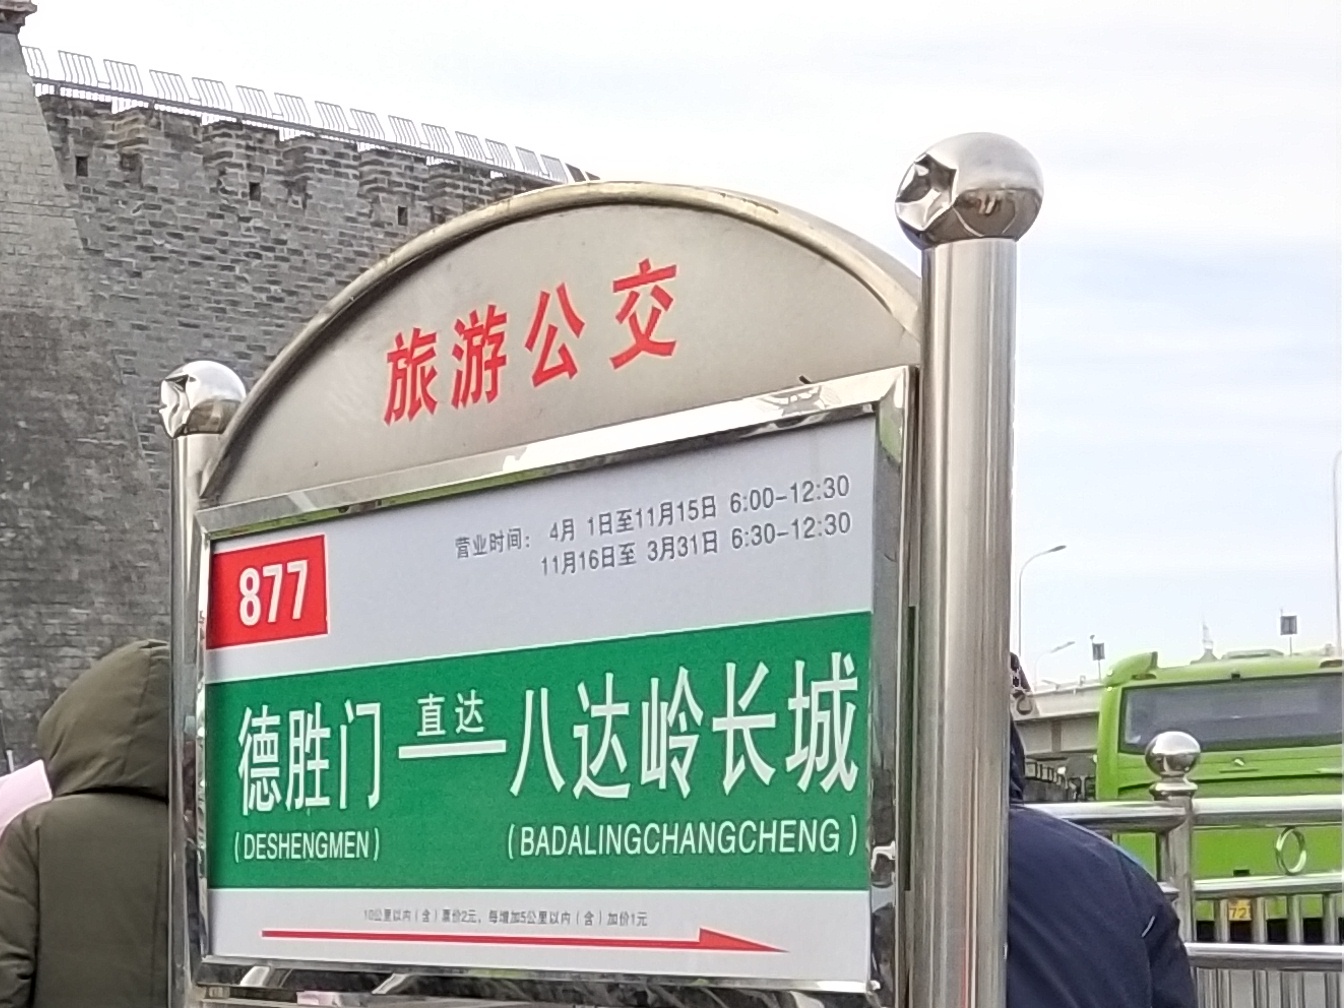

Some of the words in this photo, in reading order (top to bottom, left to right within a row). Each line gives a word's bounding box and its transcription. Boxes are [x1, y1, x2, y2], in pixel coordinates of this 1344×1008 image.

[384, 258, 676, 425] 旅游公交
[455, 526, 531, 558] 营业时间：
[549, 518, 575, 542] 4月
[587, 495, 717, 537] 1日至11月15日
[730, 474, 850, 513] 6:00-12:30
[541, 541, 637, 576] 11月16日至
[647, 530, 718, 562] 3月31日
[731, 511, 851, 550] 6:30-12:30
[238, 559, 308, 627] 877
[238, 699, 381, 816] 德胜门
[509, 651, 859, 799] 八达岭长城
[417, 688, 485, 738] 直达
